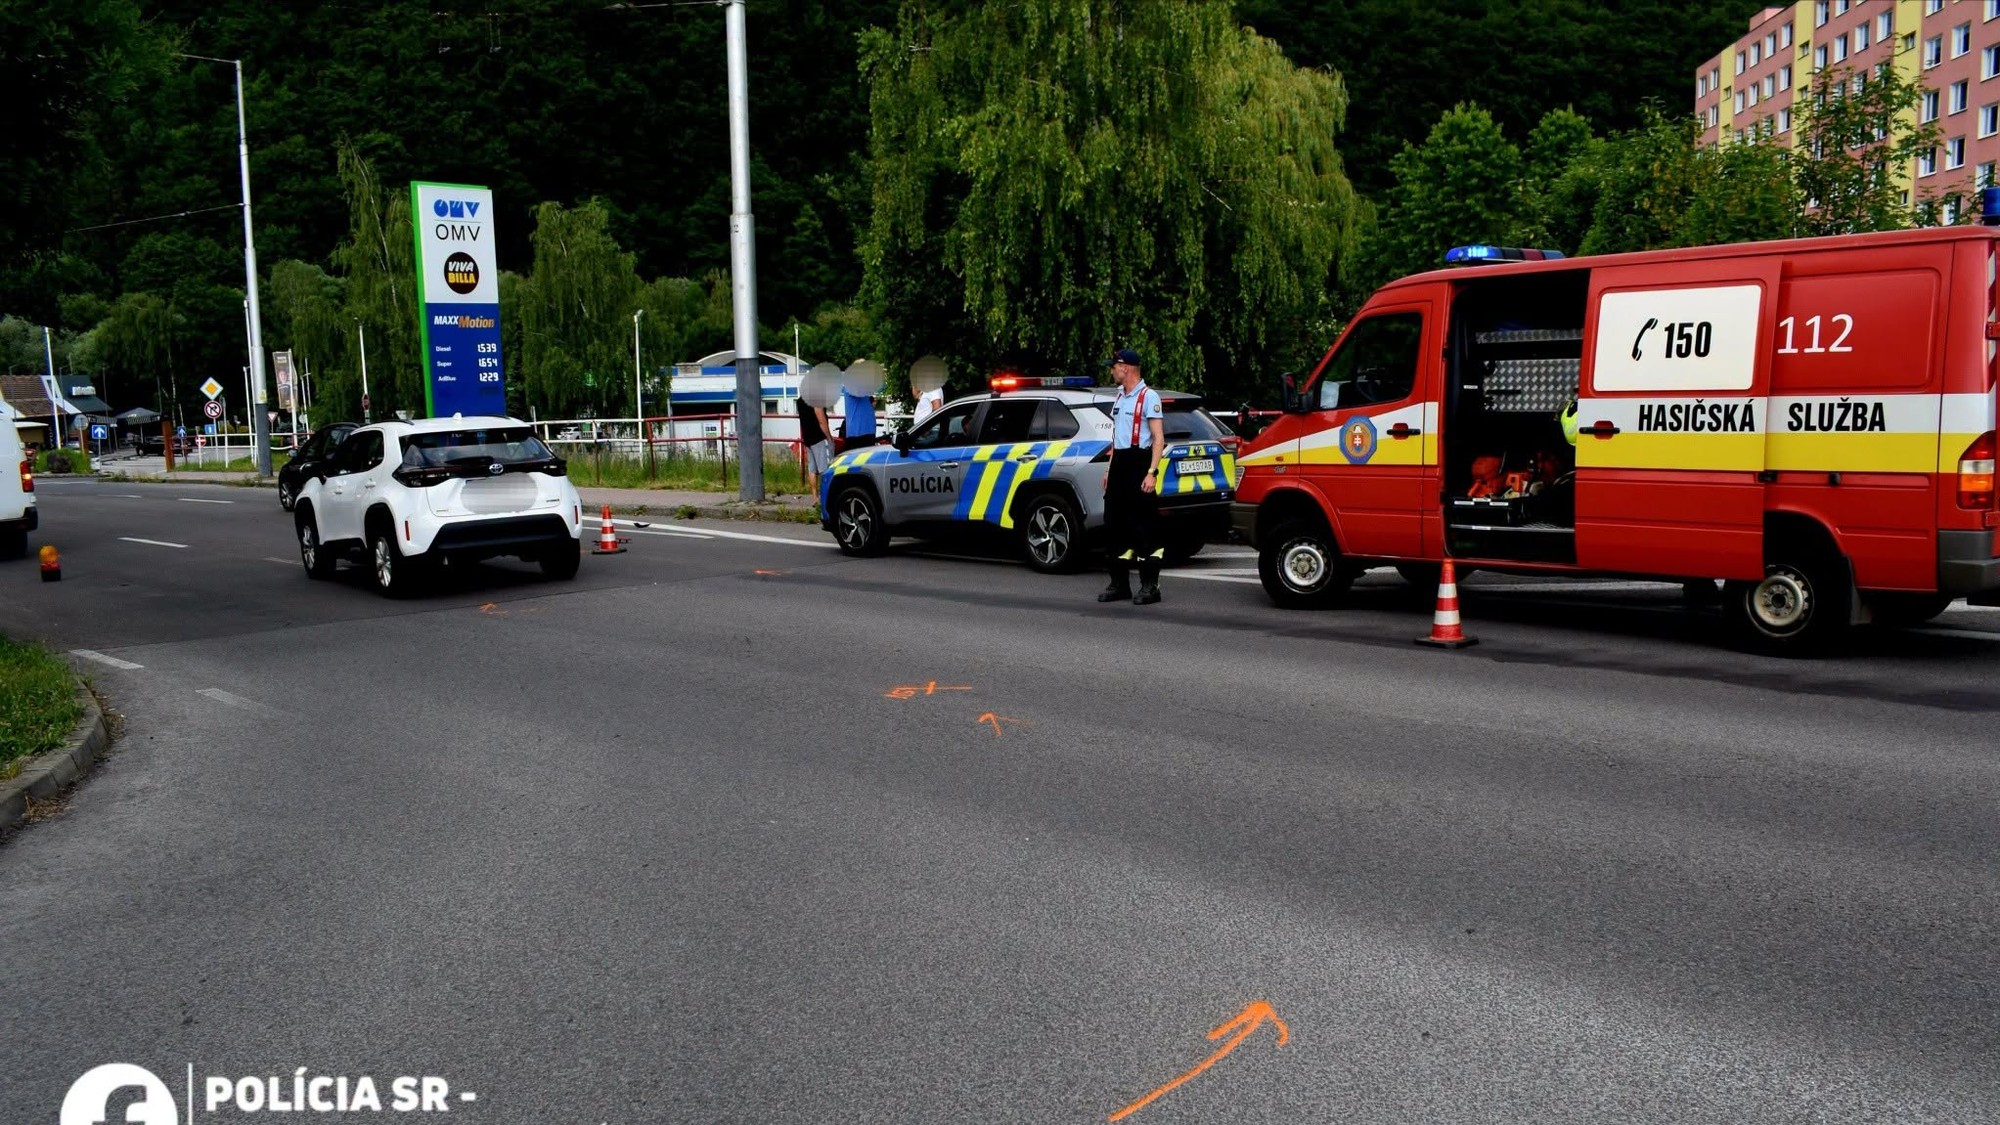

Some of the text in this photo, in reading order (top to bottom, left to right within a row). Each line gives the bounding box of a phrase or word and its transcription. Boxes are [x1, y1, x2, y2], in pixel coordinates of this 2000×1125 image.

[435, 223, 480, 241] OMV
[448, 261, 474, 272] VIVA
[448, 272, 476, 284] BILLA
[1664, 321, 1712, 359] 150
[1777, 313, 1854, 354] 112
[1638, 397, 1886, 432] HASIČSKÁ SLUŽBA
[889, 473, 955, 494] POLÍCIA
